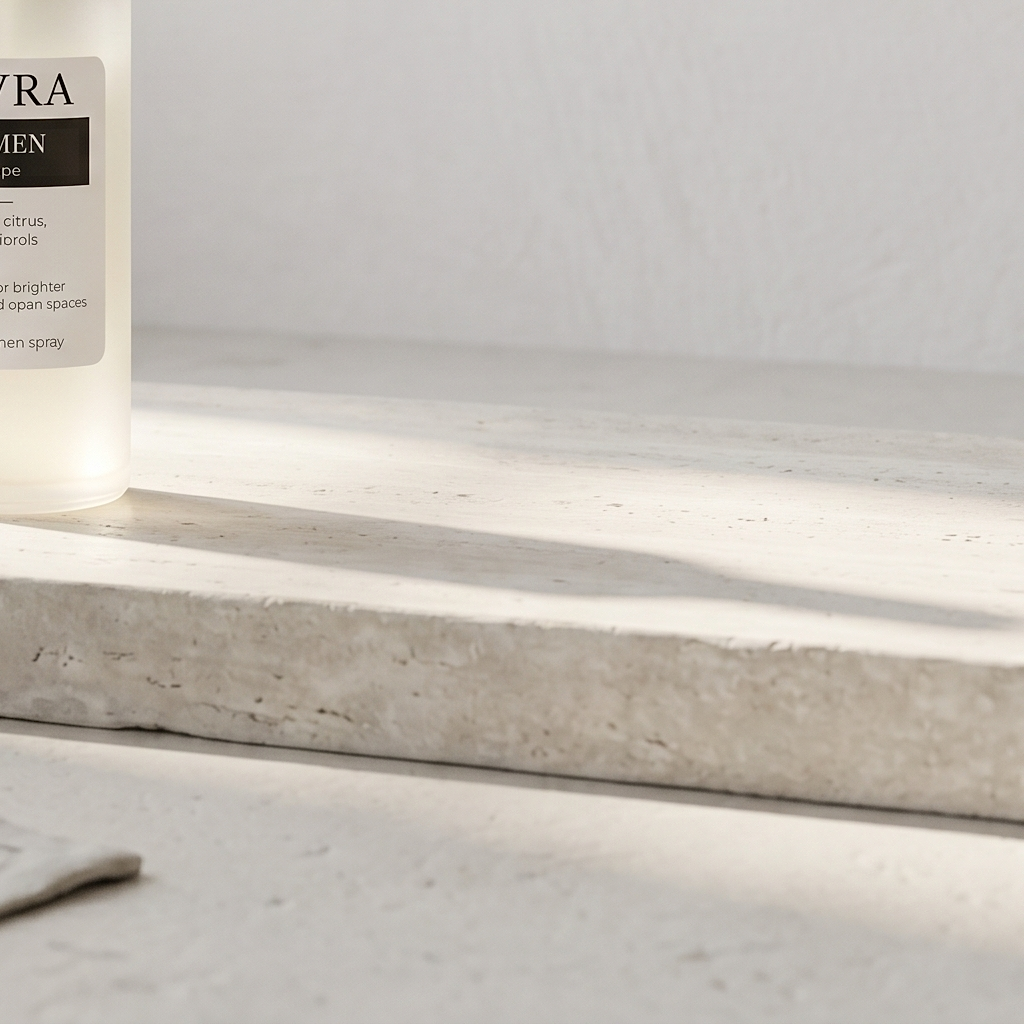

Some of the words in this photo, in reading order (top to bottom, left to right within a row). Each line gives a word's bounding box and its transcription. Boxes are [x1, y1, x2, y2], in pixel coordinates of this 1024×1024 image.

[3, 214, 47, 229] citrus,
[13, 280, 66, 296] brighter
[8, 300, 43, 314] opan
[46, 298, 88, 313] spaces
[28, 337, 65, 353] spray
